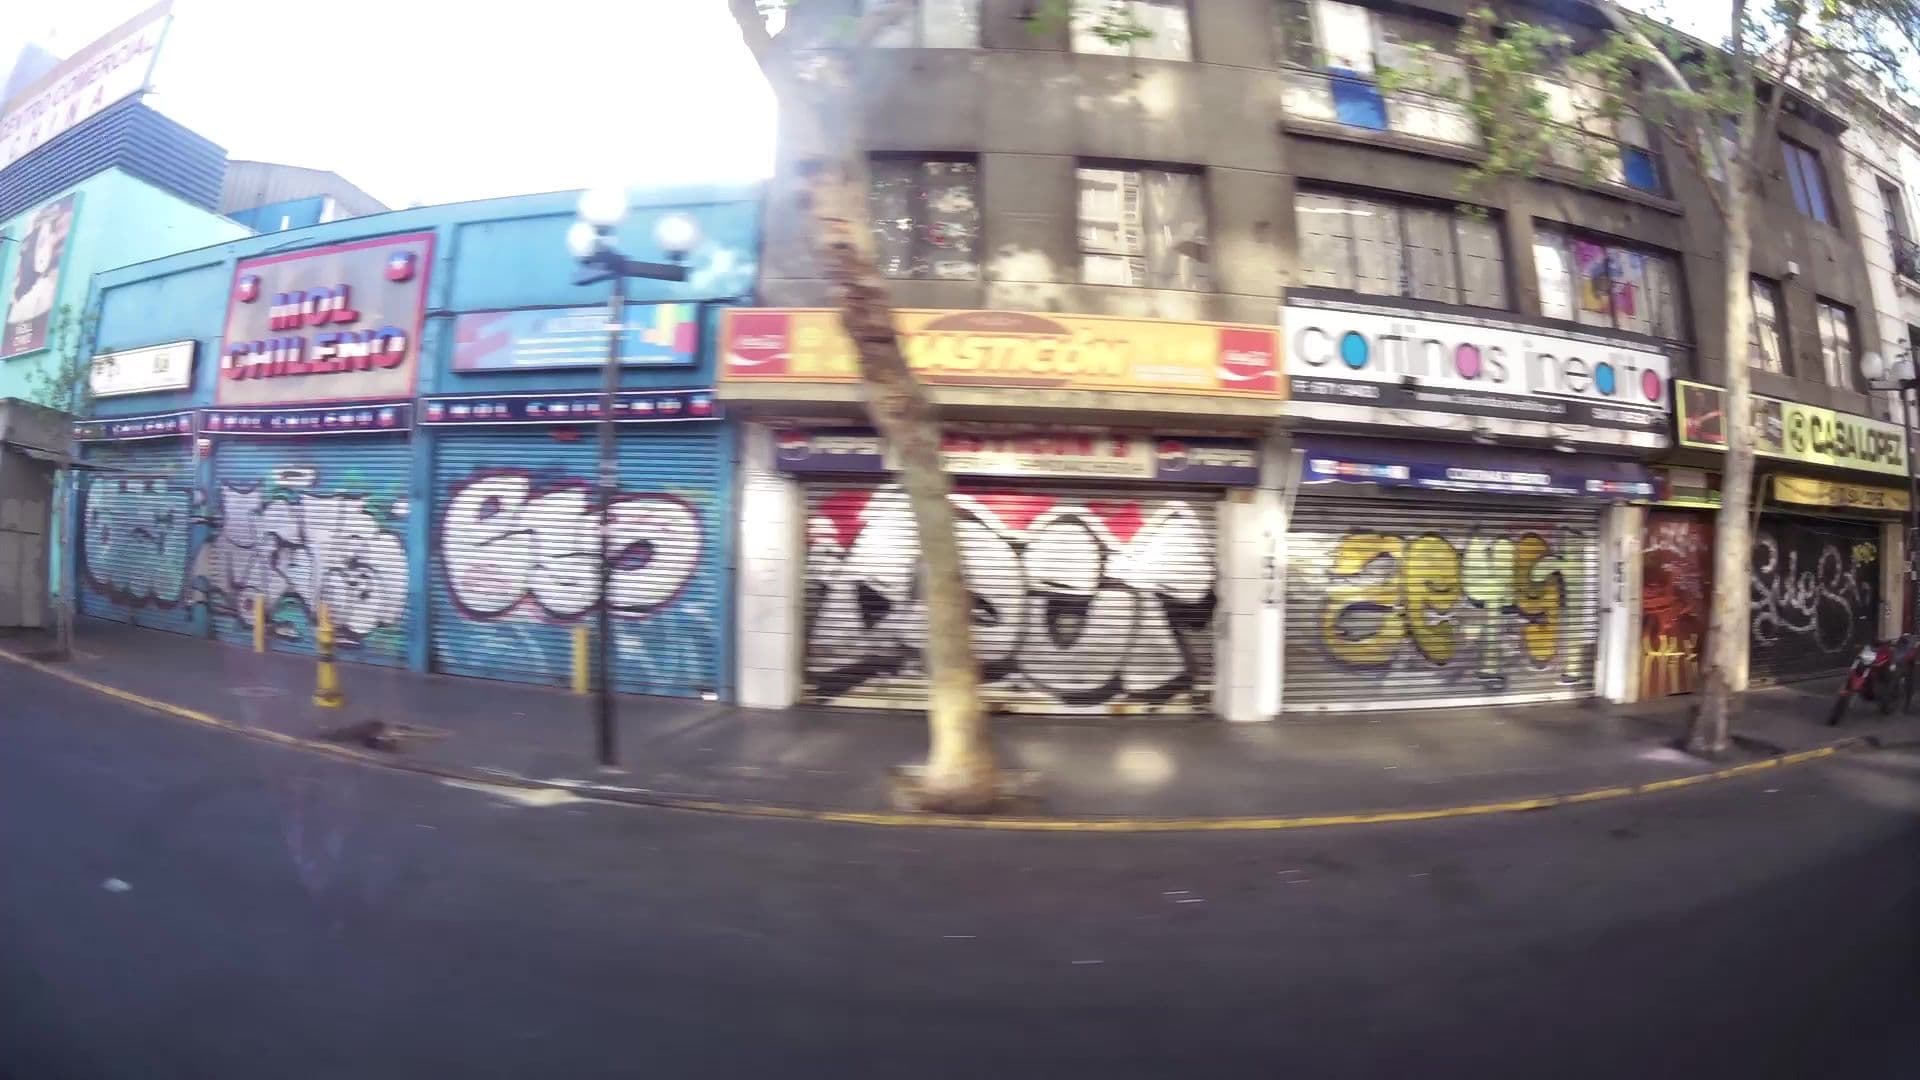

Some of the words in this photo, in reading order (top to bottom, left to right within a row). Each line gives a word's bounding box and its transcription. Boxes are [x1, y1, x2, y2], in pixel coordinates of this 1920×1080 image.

[221, 325, 409, 380] CHILENO
[1294, 320, 1509, 384] cortinas
[1524, 338, 1663, 404] inedito
[1810, 415, 1857, 460] CASA
[1858, 425, 1903, 466] LOPEZ
